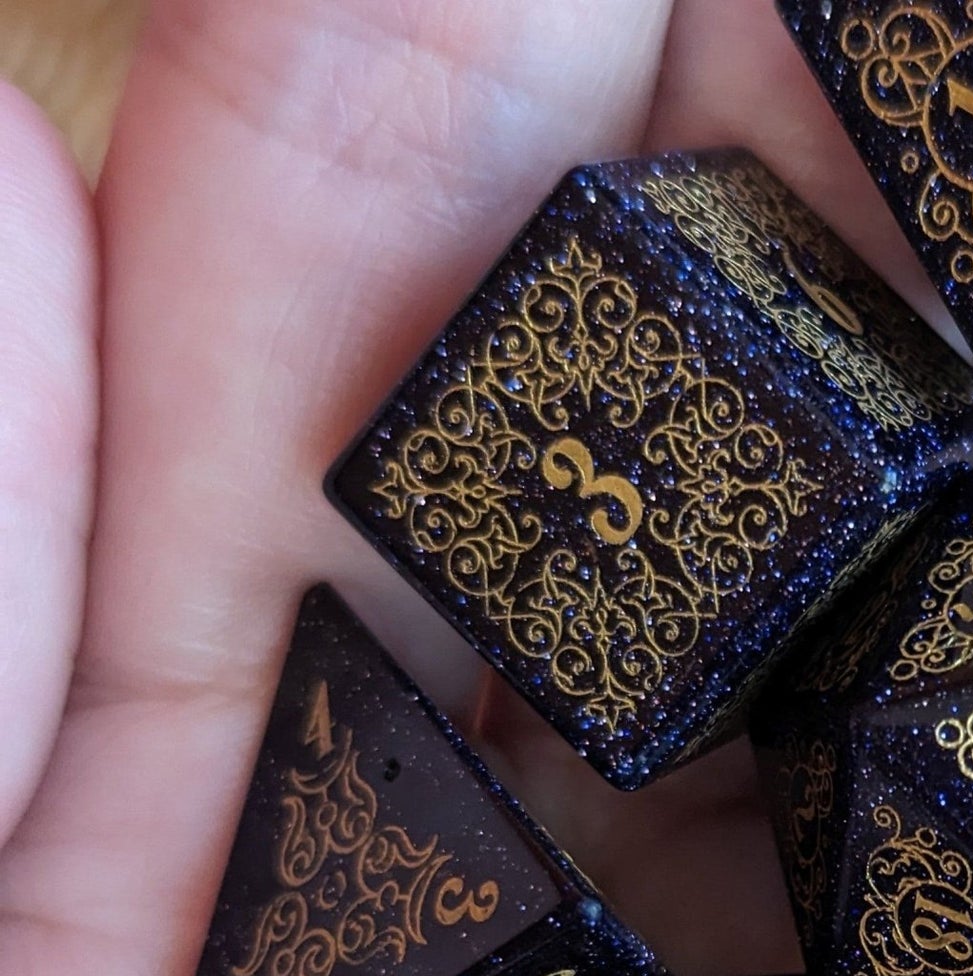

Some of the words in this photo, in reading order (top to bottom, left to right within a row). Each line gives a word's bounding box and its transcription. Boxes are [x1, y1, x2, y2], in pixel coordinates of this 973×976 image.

[541, 438, 643, 546] 3
[303, 680, 334, 758] 4
[434, 876, 499, 926] 3
